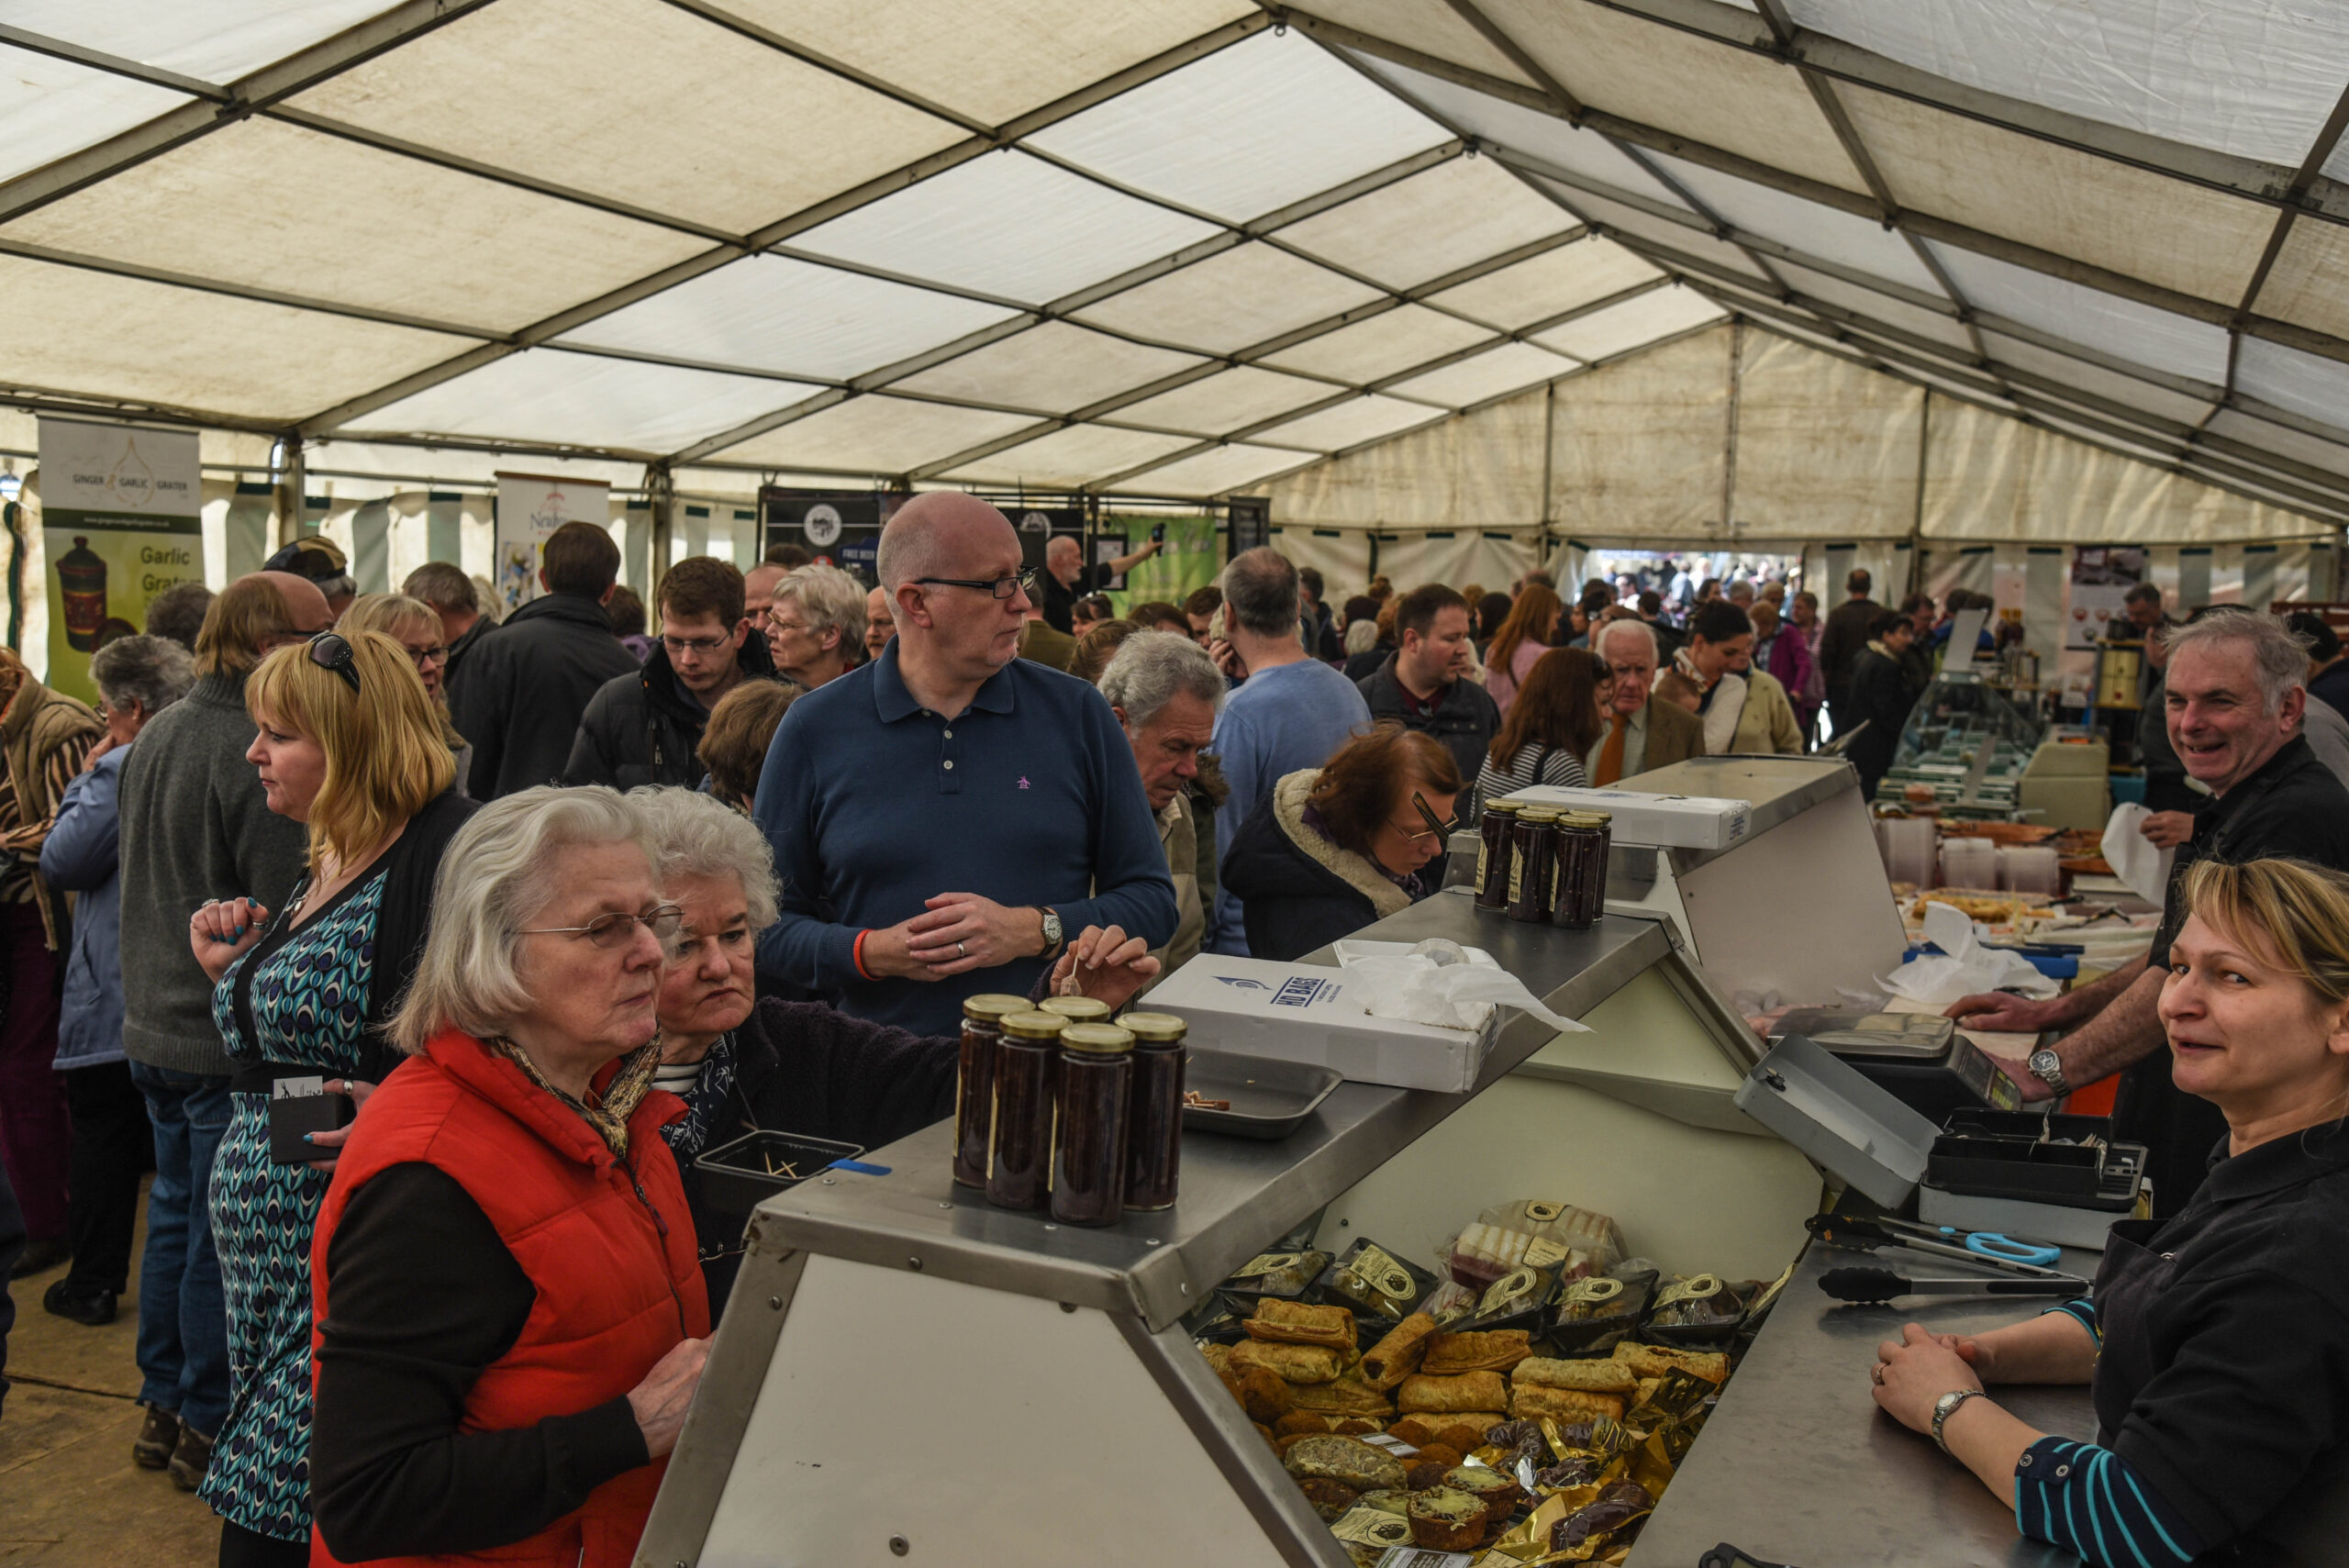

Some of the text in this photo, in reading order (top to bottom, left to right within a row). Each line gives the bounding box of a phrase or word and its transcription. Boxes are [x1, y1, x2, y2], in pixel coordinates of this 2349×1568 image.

[72, 473, 105, 485] GINGER
[119, 477, 149, 489] GARLIC
[156, 481, 188, 492] GRATER
[140, 546, 191, 565] Garlic
[1285, 976, 1321, 995] BAGS
